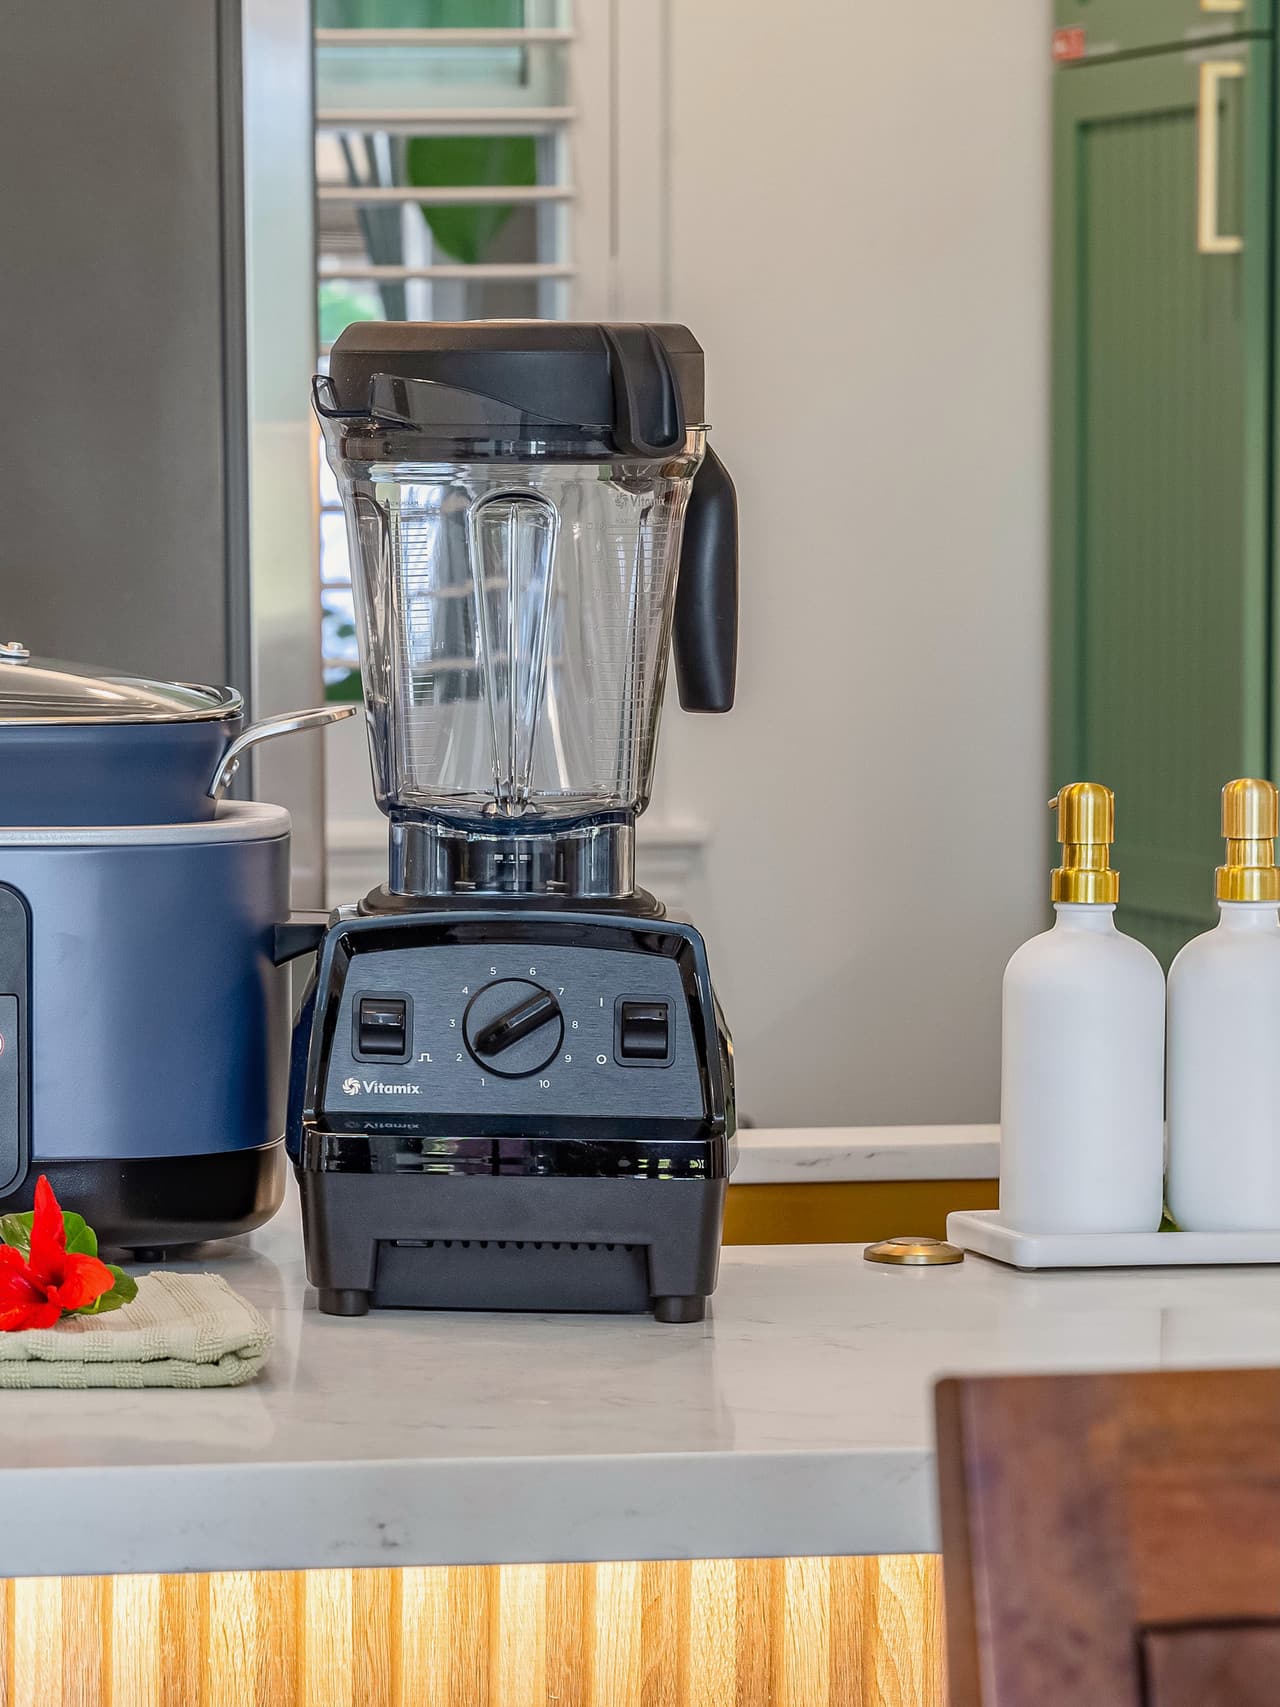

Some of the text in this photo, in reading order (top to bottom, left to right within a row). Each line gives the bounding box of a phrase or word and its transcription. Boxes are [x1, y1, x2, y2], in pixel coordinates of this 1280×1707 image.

[490, 966, 497, 976] 5
[529, 967, 537, 976] 6
[461, 986, 469, 995] 4
[558, 987, 565, 996] 7
[449, 1019, 456, 1028] 3
[572, 1020, 579, 1029] 8
[456, 1053, 463, 1062] 2
[564, 1054, 572, 1063] 9
[480, 1078, 485, 1086] 1
[539, 1079, 551, 1088] 10
